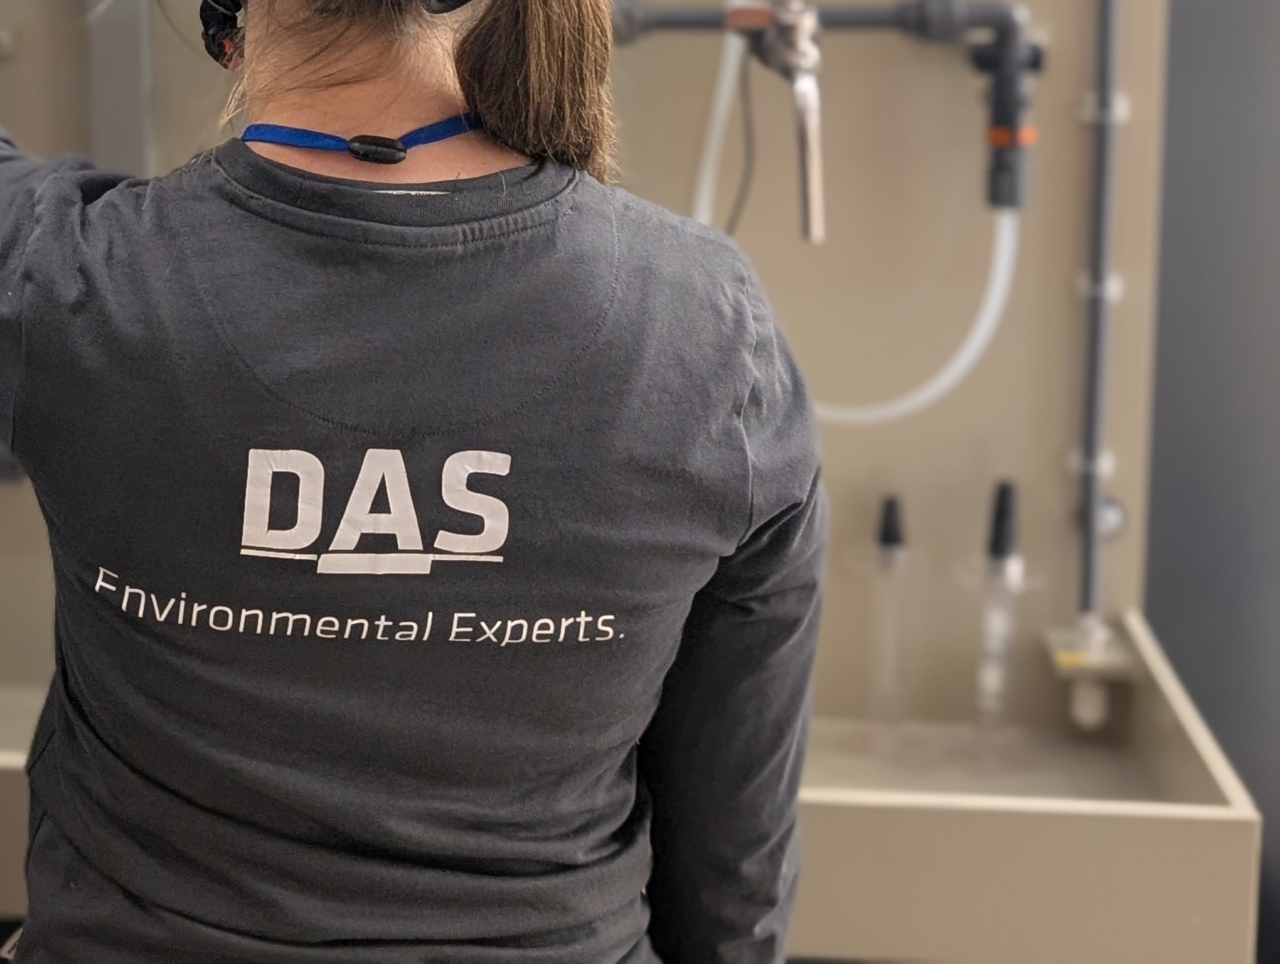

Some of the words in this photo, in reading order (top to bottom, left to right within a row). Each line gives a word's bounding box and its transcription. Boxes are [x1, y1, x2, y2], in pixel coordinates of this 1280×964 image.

[240, 448, 512, 554] DAS
[94, 566, 434, 642] Environmental
[448, 610, 625, 647] Experts.
